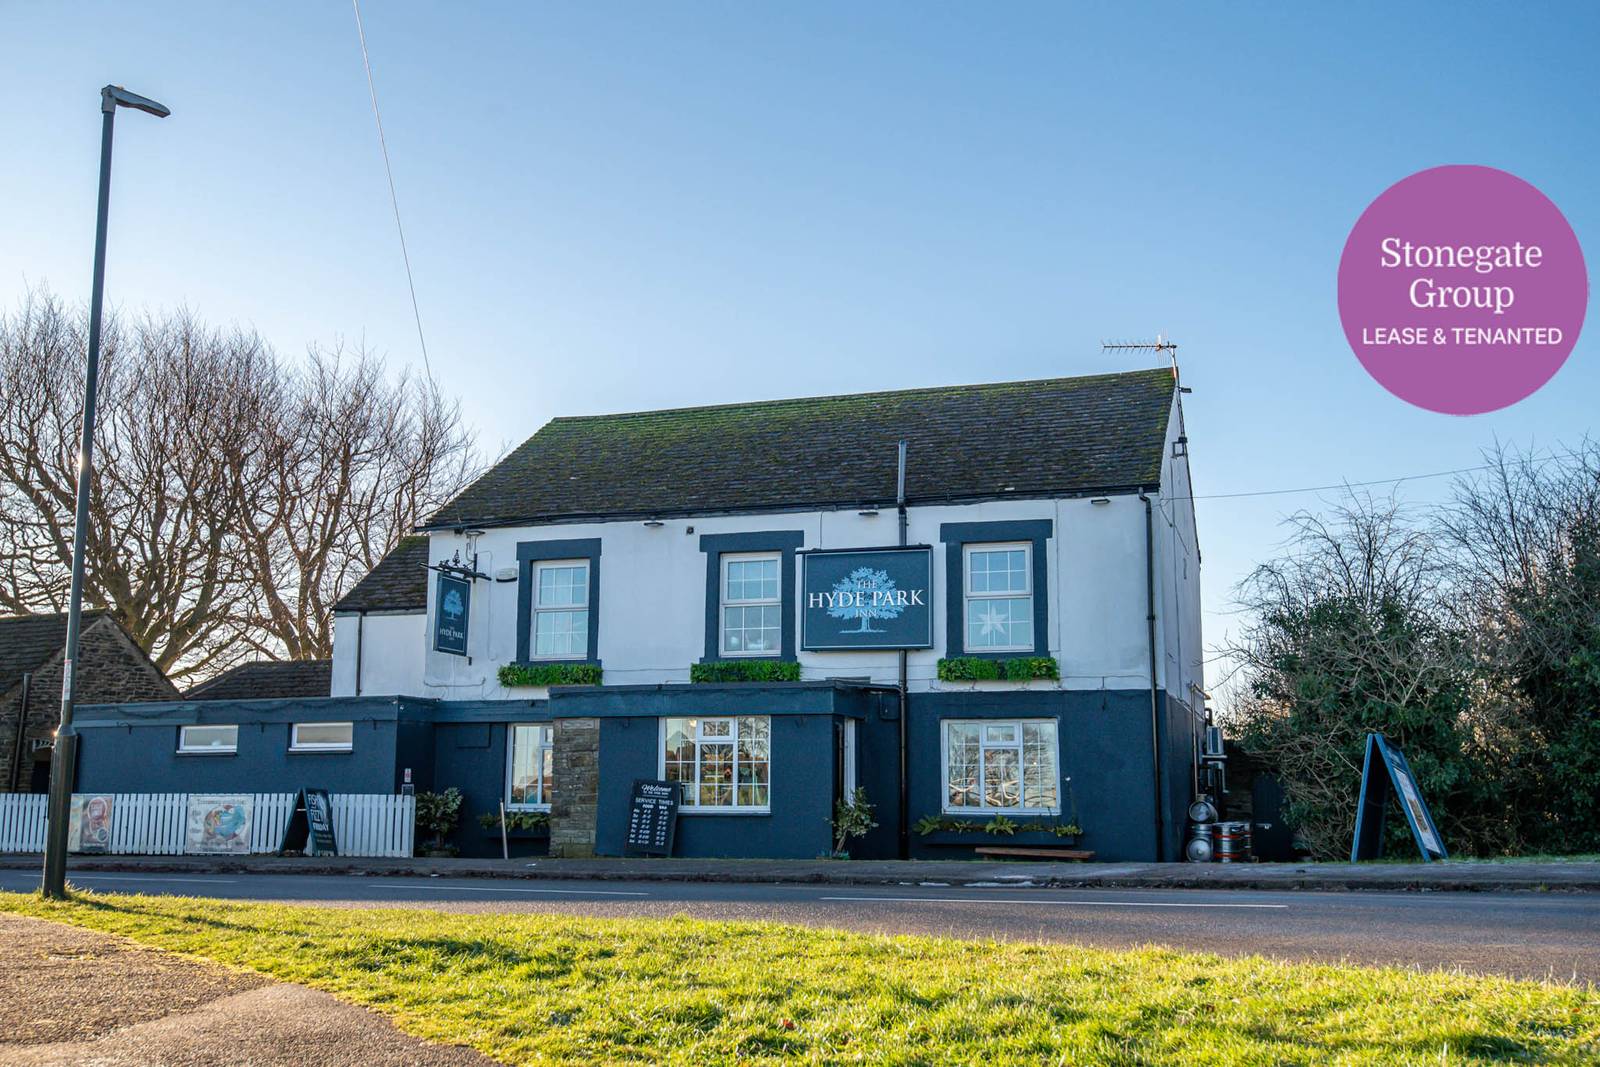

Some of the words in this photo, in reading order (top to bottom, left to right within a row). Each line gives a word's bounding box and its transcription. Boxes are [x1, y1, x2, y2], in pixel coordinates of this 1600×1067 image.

[858, 580, 877, 589] THE
[809, 592, 865, 608] HYDE
[872, 590, 925, 607] PARK
[855, 609, 877, 618] INN
[641, 784, 672, 792] Welcome
[312, 822, 329, 831] FRIDAY
